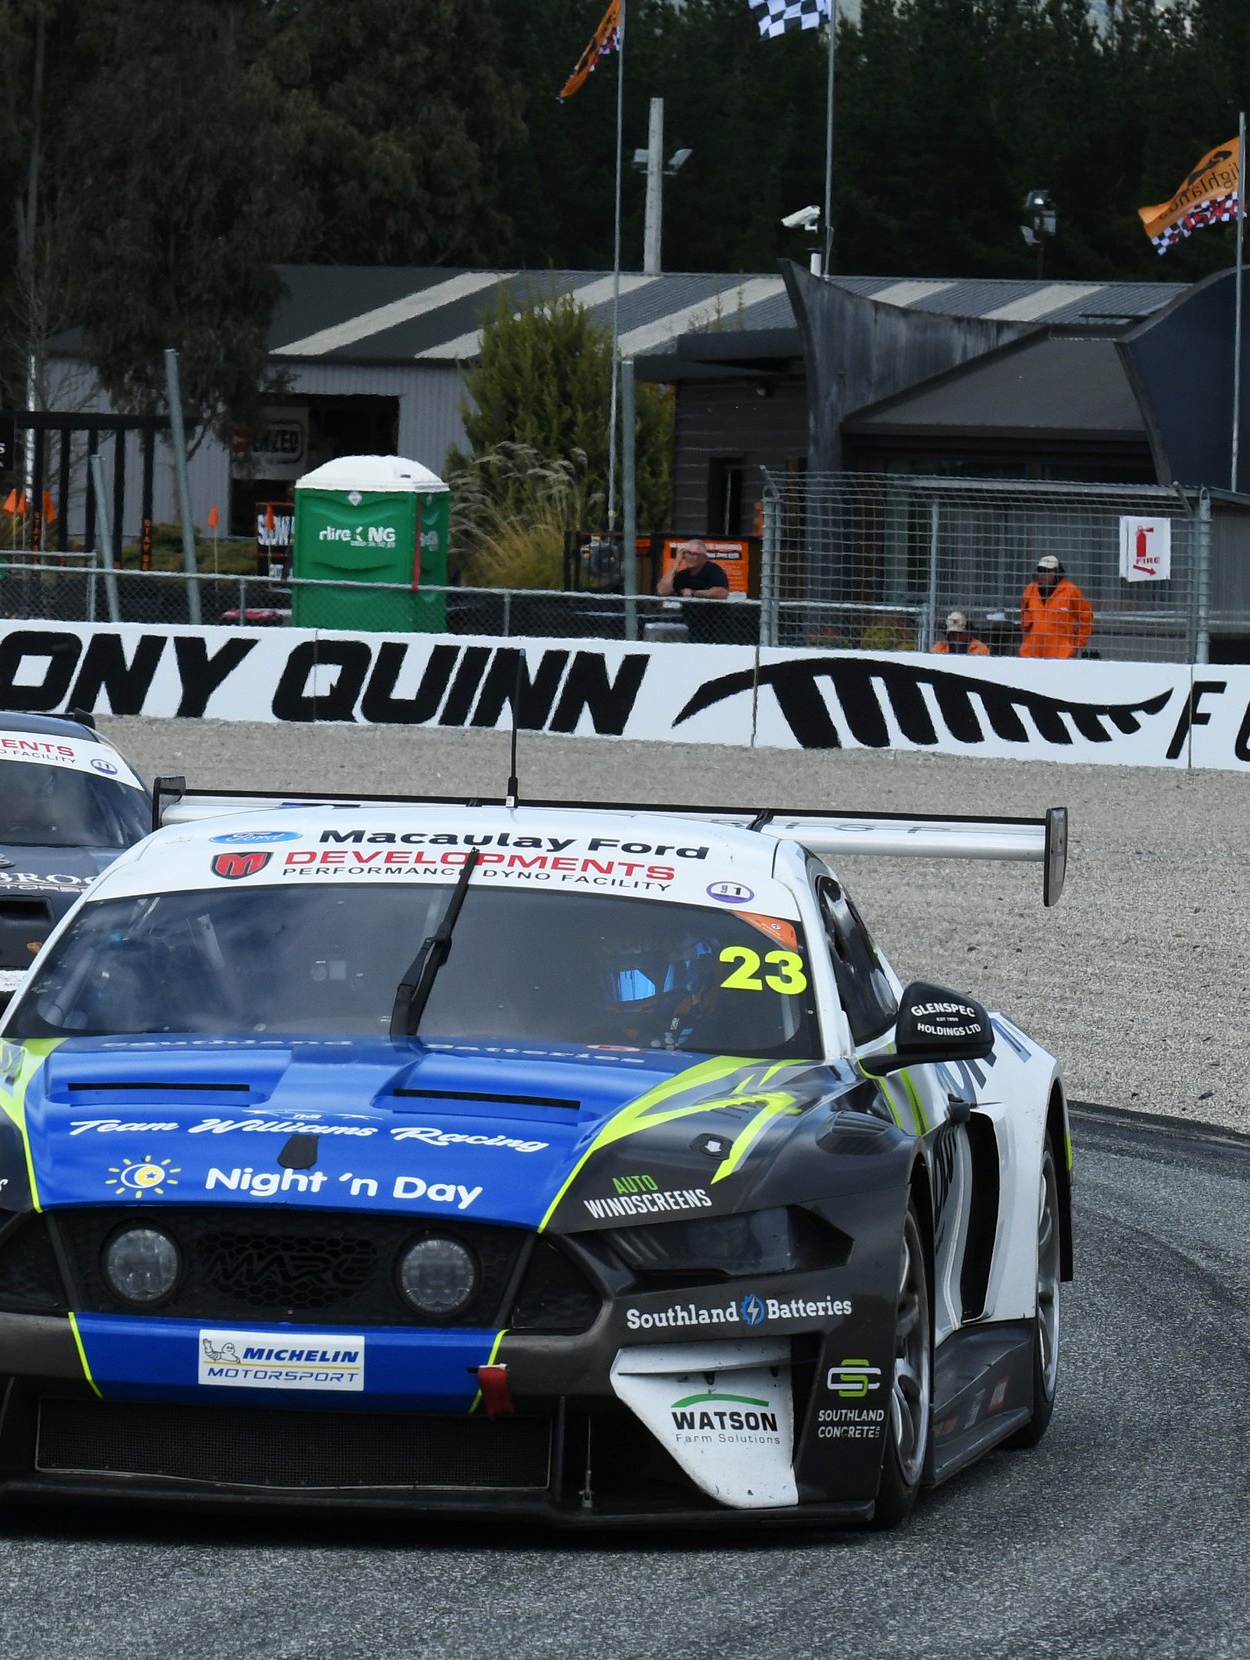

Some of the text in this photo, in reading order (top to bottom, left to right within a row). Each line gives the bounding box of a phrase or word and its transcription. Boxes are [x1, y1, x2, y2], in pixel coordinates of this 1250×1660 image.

[1135, 556, 1160, 565] FIRE
[272, 640, 650, 736] QUINN
[1166, 681, 1250, 762] F
[12, 750, 76, 764] FACILITY
[319, 829, 710, 860] Macaulay Ford
[285, 850, 676, 881] DEVELOPMENTS
[483, 869, 551, 881] DYNO
[561, 873, 673, 893] FACILITY
[720, 946, 808, 995] 23
[911, 1002, 976, 1018] GLENSPEC
[917, 1022, 981, 1037] HOLDINGS LTD
[70, 1118, 550, 1153] Team Williams Racing
[205, 1167, 328, 1197] Night
[393, 1176, 483, 1210] Day
[612, 1174, 659, 1195] AUTO
[584, 1188, 713, 1219] WINDSCREENS
[626, 1295, 853, 1330] Southland Batteries
[242, 1347, 359, 1364] MICHELIN
[207, 1367, 359, 1383] MOTORSPORT
[671, 1411, 778, 1432] WATSON
[817, 1408, 885, 1422] SOUTHLAND
[676, 1433, 781, 1446] Farm Solutions
[817, 1425, 876, 1439] CONCRETE
